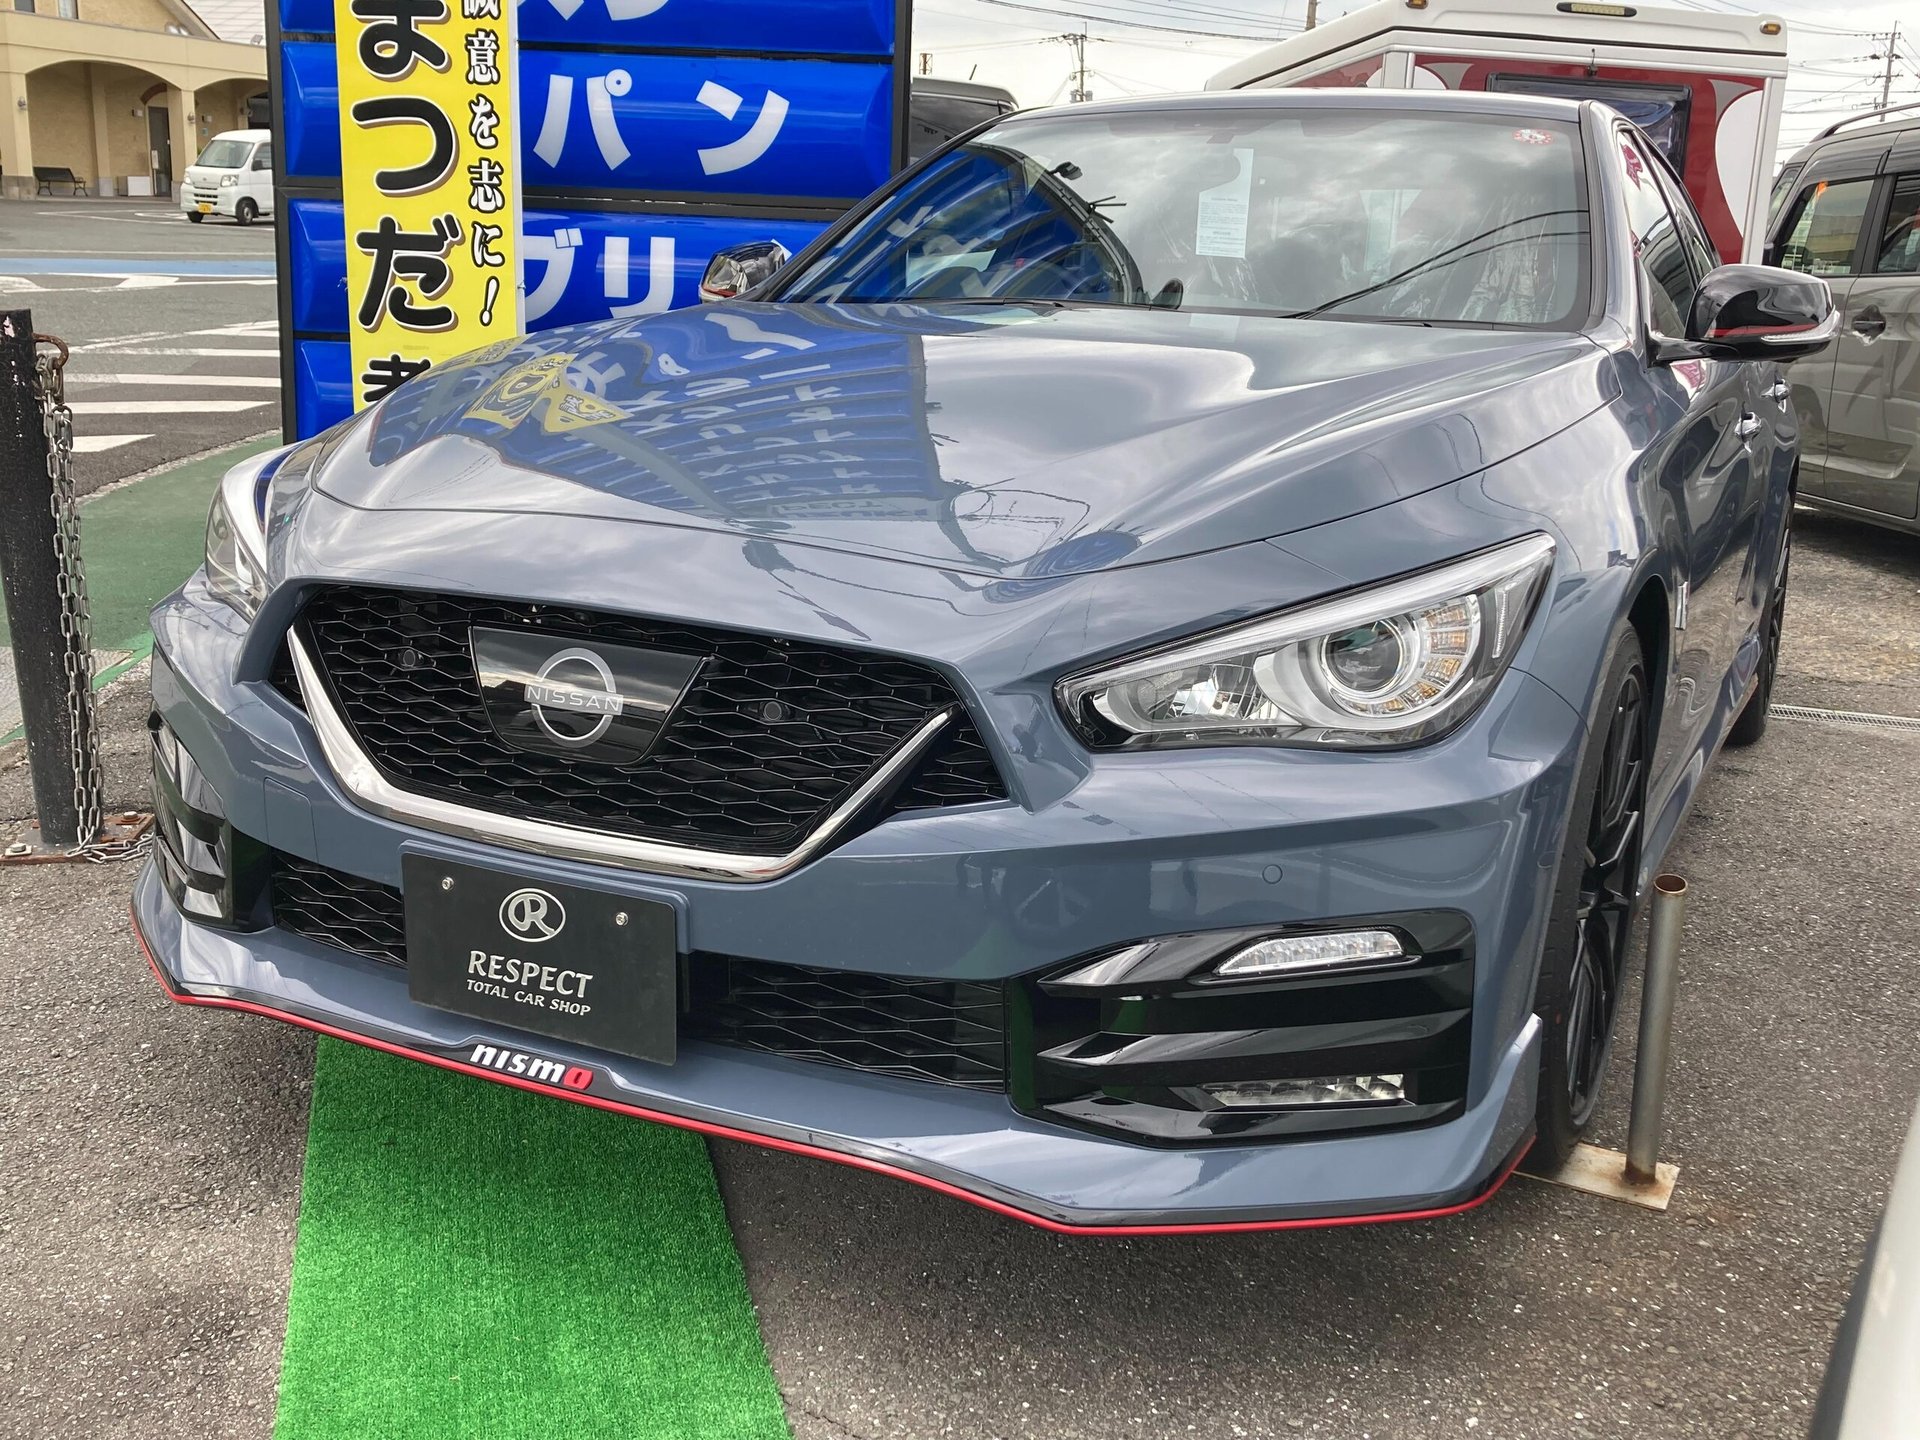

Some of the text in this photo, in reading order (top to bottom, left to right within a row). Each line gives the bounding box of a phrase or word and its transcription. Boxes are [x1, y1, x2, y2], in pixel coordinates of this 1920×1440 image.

[533, 68, 790, 176] パン
[527, 686, 620, 711] NISSAN
[468, 950, 593, 998] RESPECT
[467, 979, 591, 1016] TOTAL CAR SHOP
[469, 1044, 593, 1090] nismo
